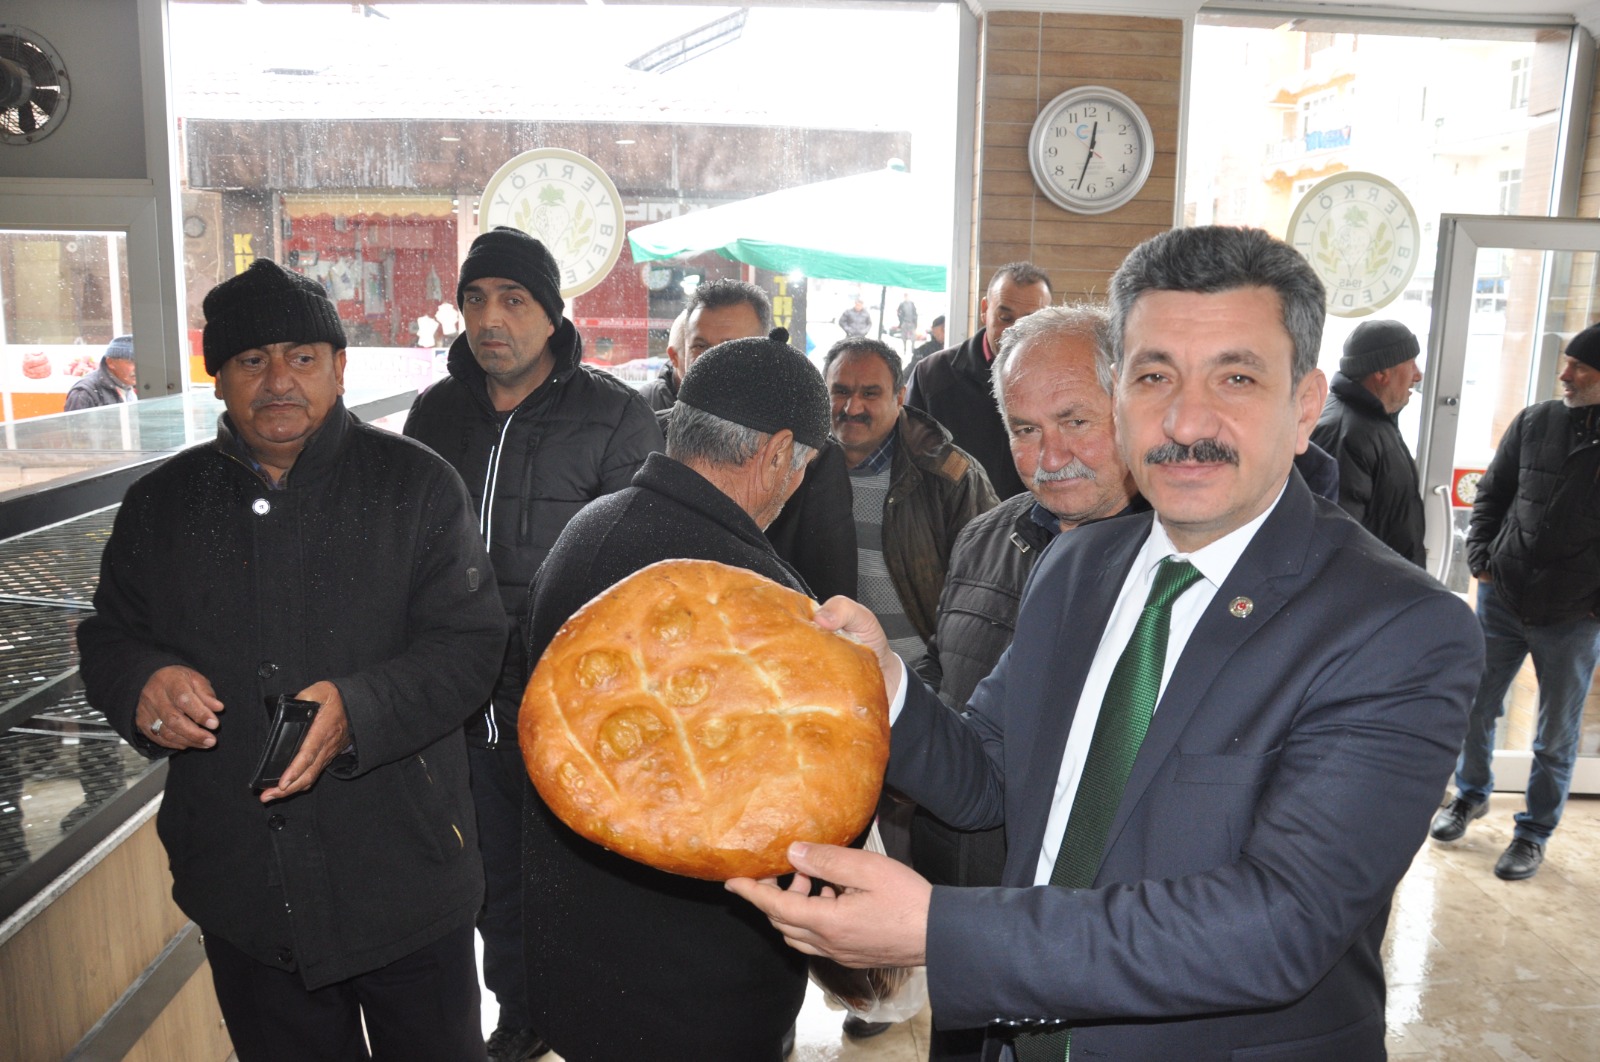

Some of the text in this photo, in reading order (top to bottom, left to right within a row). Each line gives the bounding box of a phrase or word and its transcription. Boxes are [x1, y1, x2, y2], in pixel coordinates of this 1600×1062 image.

[1068, 112, 1078, 123] 11
[1084, 106, 1096, 118] 12
[1106, 112, 1110, 122] 1
[1055, 126, 1067, 137] 10
[1118, 124, 1127, 135] 2
[1048, 147, 1058, 158] 9
[1124, 144, 1133, 155] 3
[1054, 165, 1064, 176] 8
[1118, 163, 1127, 174] 4
[1068, 179, 1078, 190] 7
[1105, 177, 1114, 188] 5
[1087, 183, 1096, 194] 6
